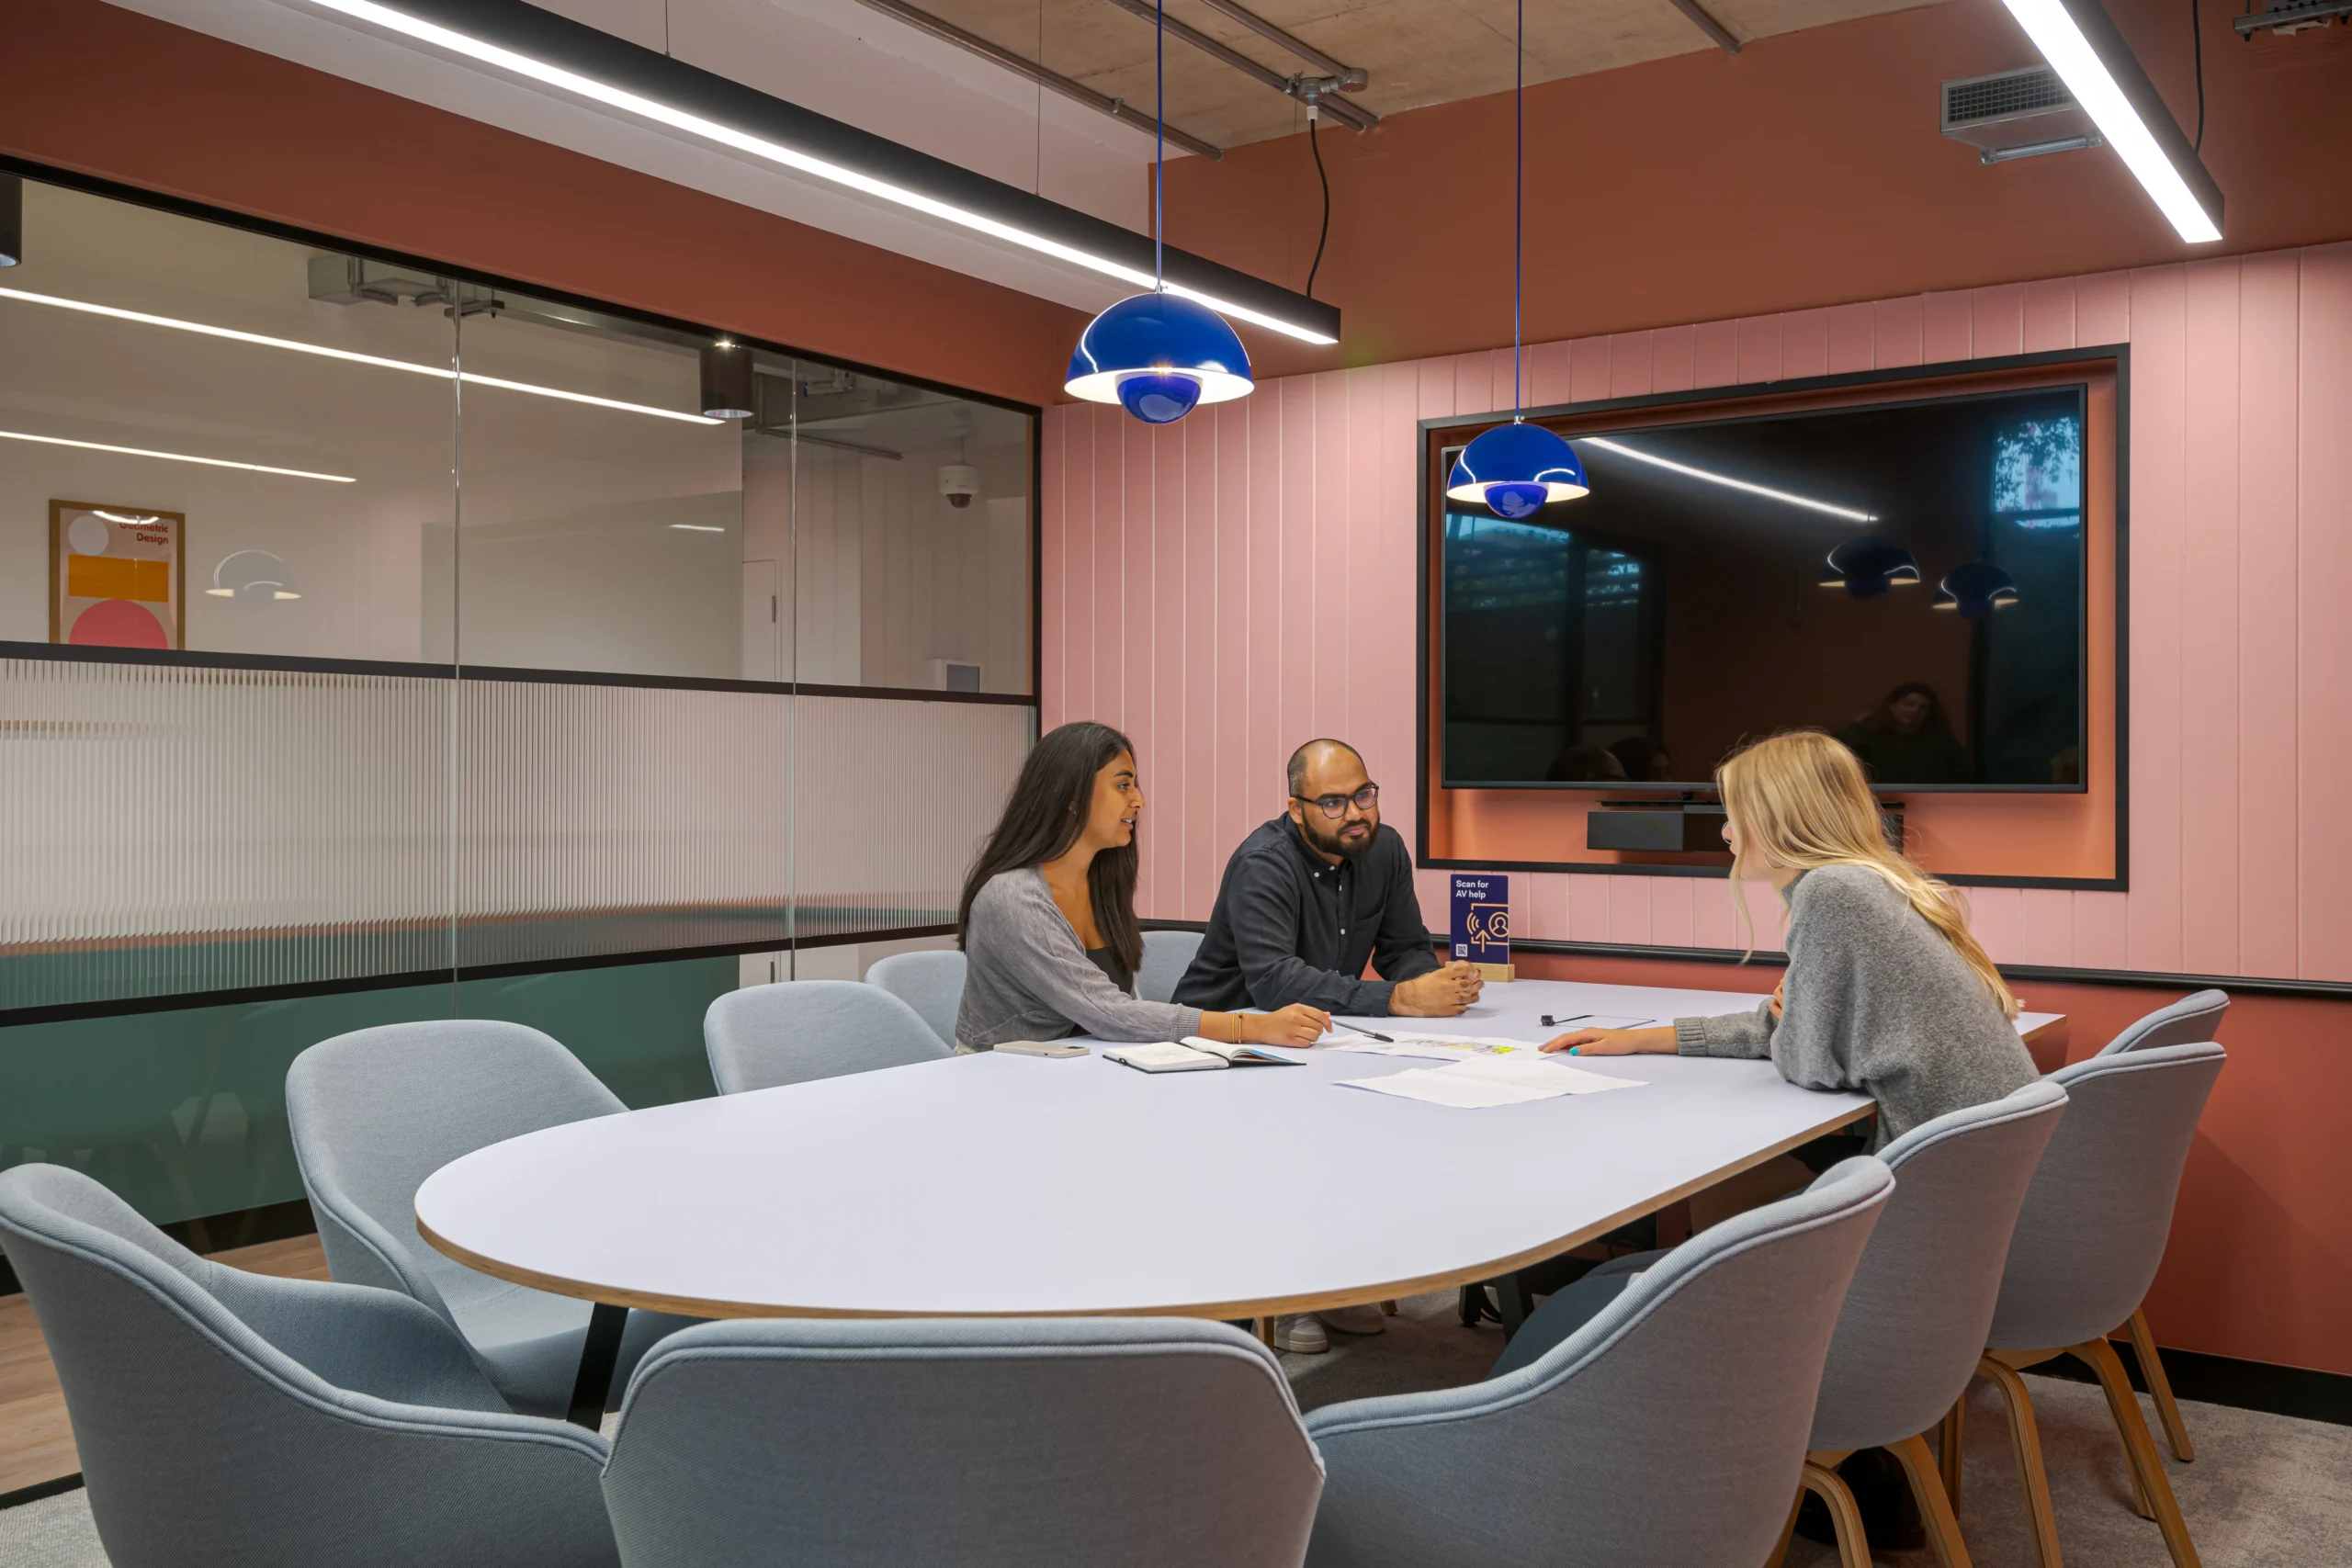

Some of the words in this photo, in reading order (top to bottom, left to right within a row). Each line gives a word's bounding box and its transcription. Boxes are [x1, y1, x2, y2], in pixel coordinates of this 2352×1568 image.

[136, 533, 169, 545] Design
[1477, 880, 1488, 888] for
[1468, 890, 1486, 899] help
